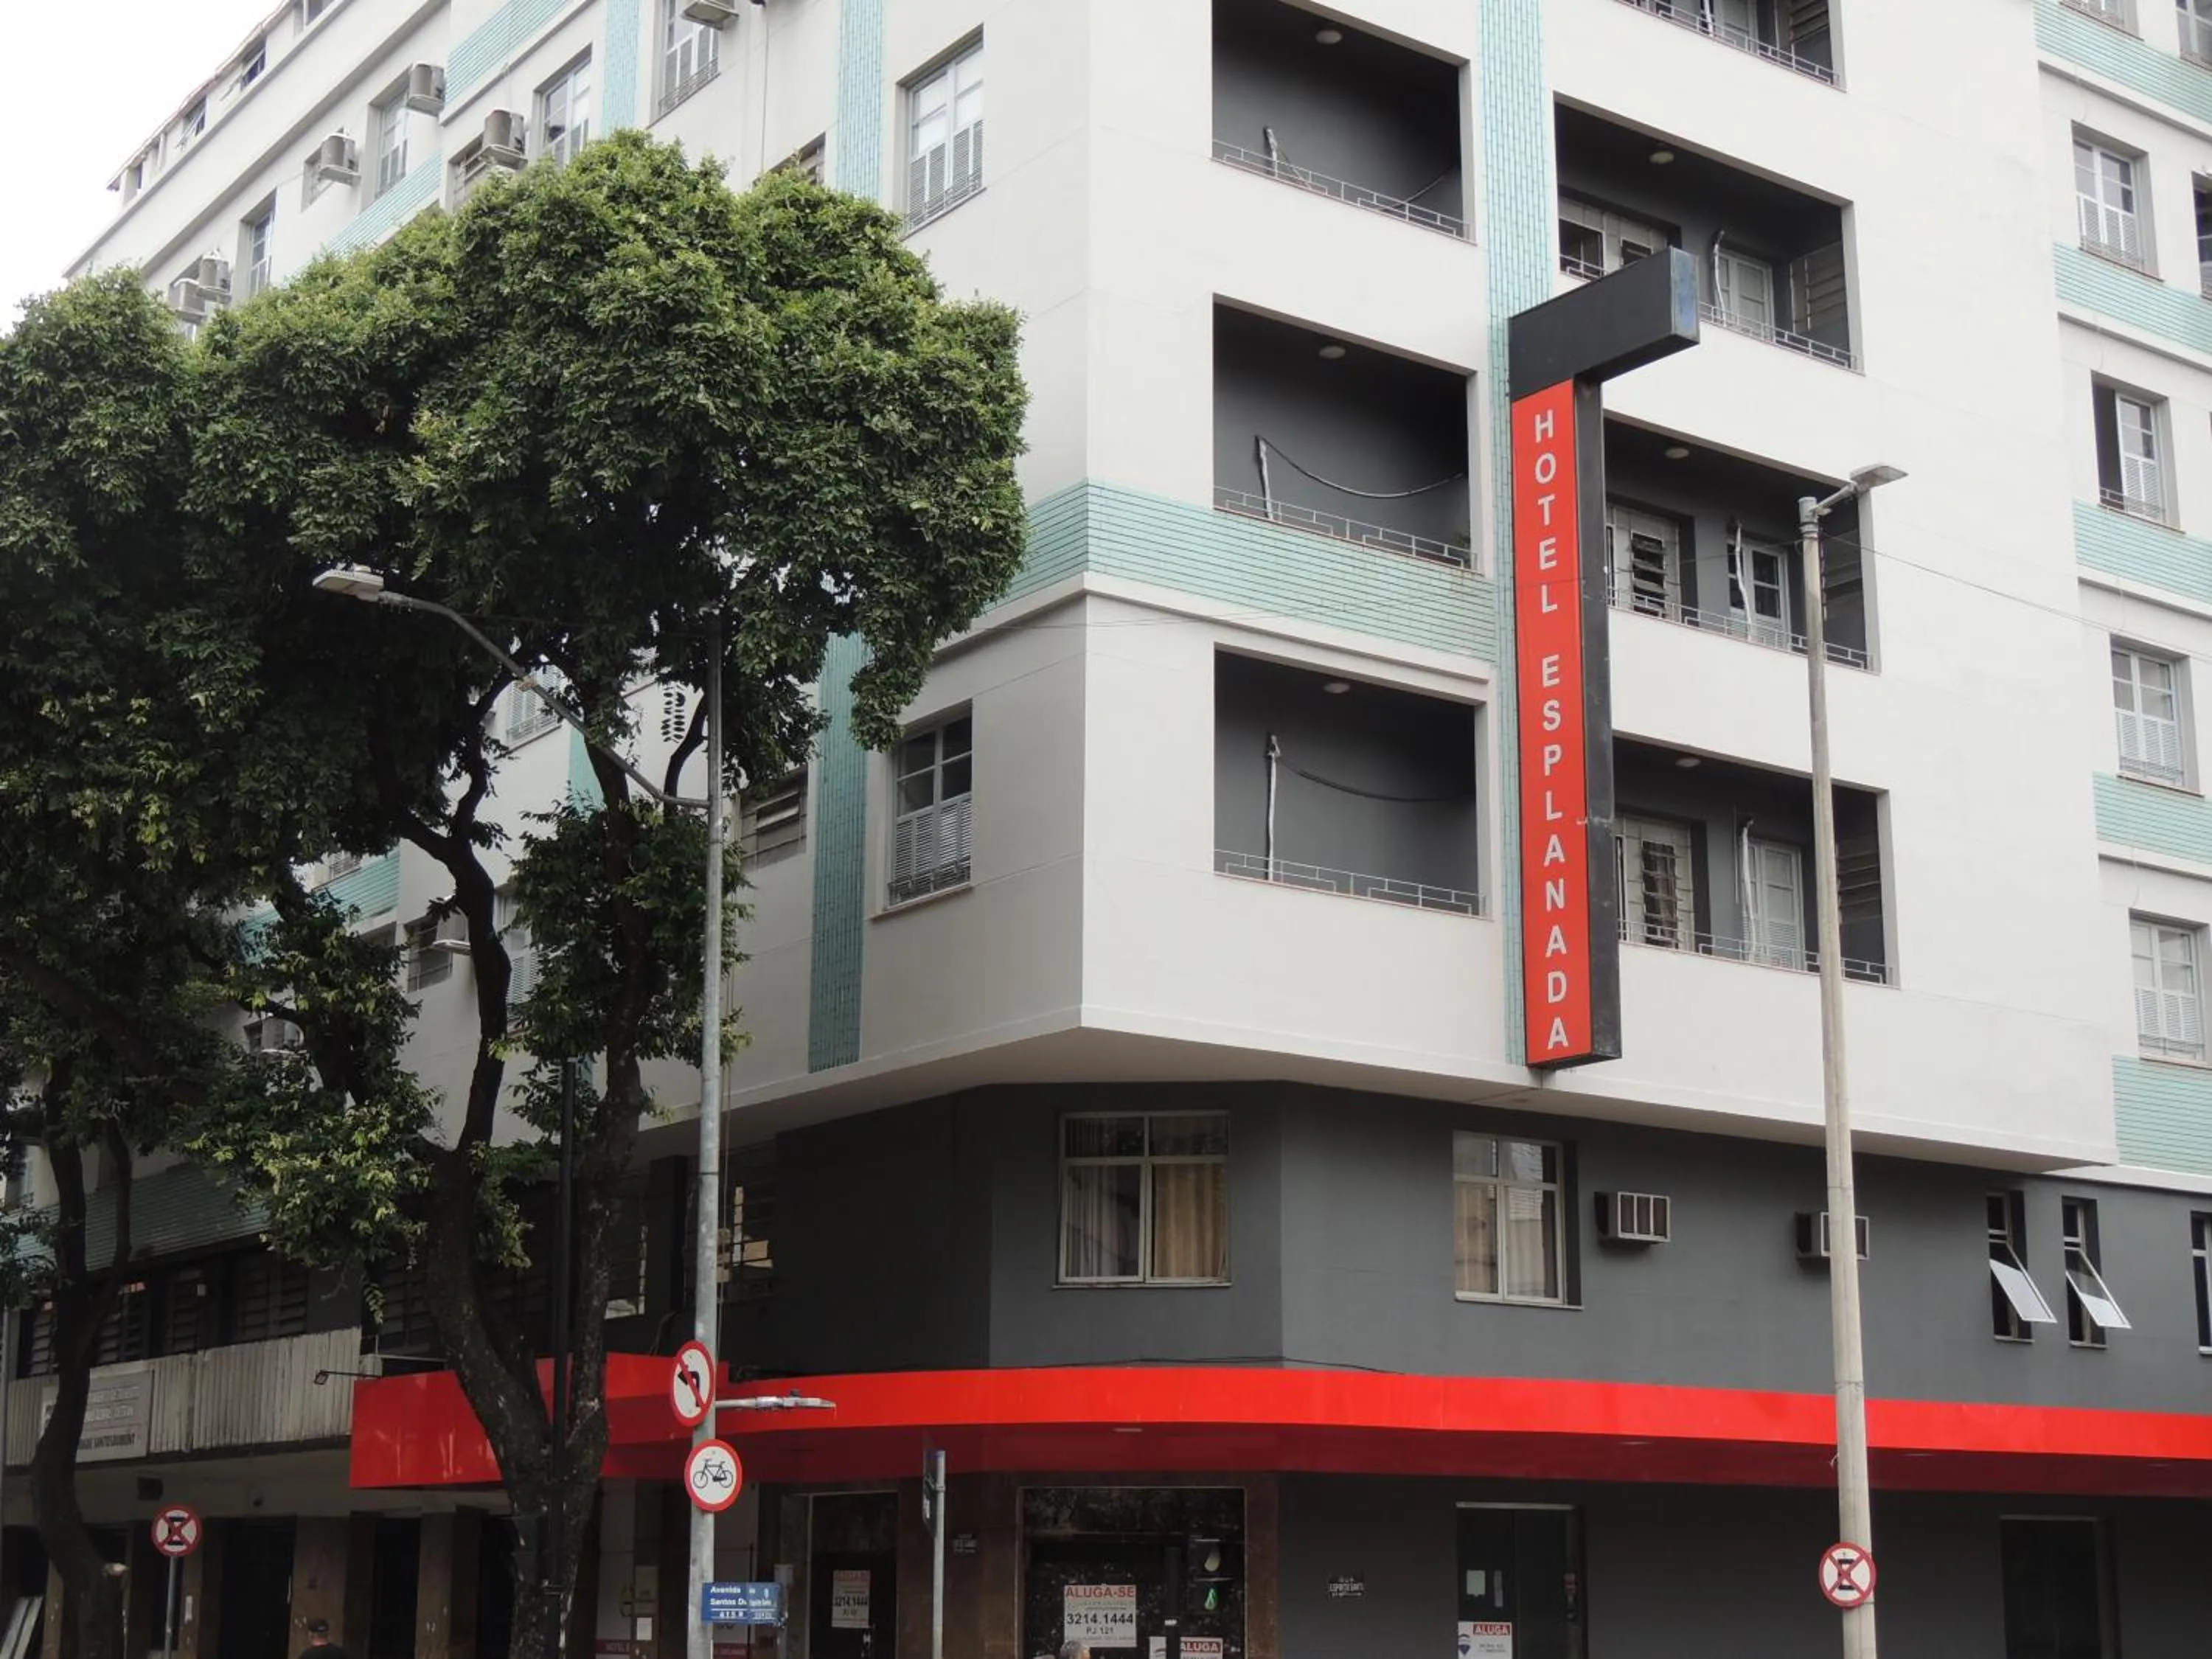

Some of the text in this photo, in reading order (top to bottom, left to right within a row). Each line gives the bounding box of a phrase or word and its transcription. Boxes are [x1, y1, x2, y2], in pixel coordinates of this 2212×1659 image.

[1534, 409, 1569, 1051] HOTEL ESPLANADA
[710, 1585, 741, 1593] Avenida
[1065, 1586, 1135, 1599] ALUGA-SE
[1066, 1612, 1133, 1624] 3214.1444
[1475, 1625, 1509, 1634] ALUGA
